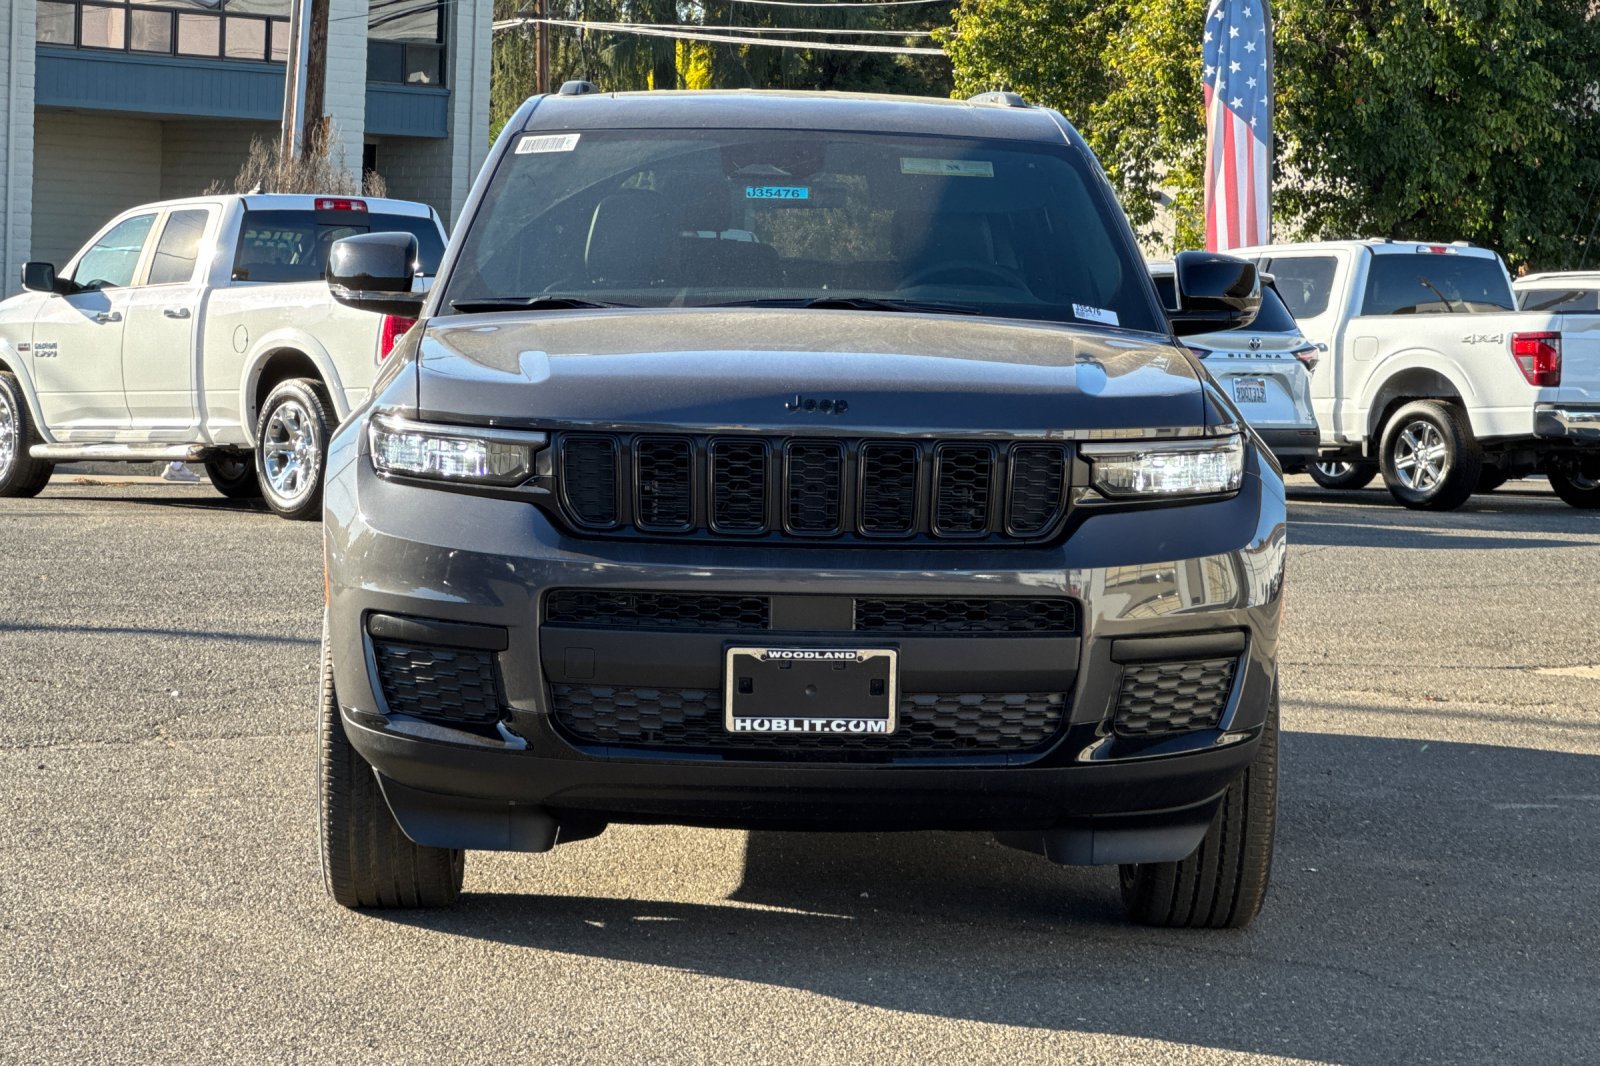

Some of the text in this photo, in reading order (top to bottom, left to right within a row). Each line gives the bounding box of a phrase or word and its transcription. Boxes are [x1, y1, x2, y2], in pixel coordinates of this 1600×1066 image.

[747, 187, 800, 198] J35476
[785, 394, 848, 415] Jeep
[768, 651, 856, 659] WOODLAND
[735, 718, 886, 732] HOBLIT.COM
